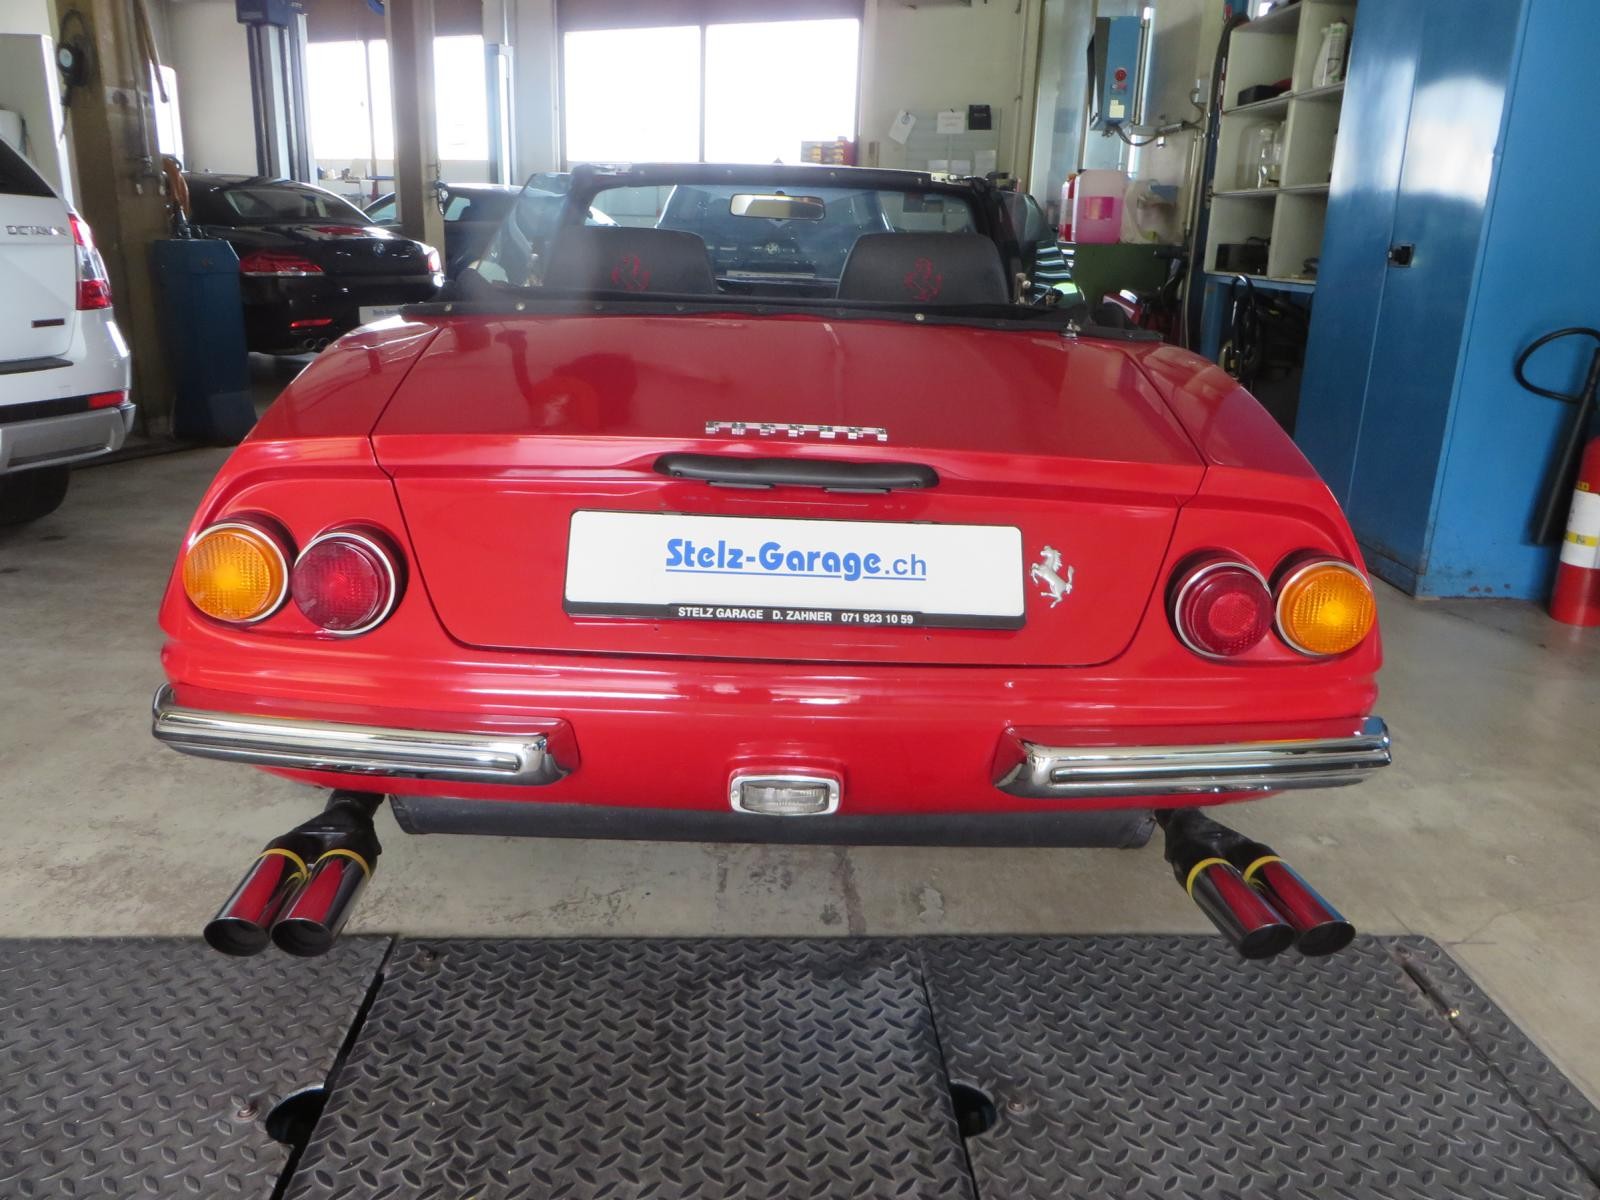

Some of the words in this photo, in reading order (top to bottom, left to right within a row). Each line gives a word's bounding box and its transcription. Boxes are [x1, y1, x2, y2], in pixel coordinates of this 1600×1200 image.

[665, 538, 927, 581] Stelz-Garage.ch
[678, 606, 714, 618] STELZ
[715, 608, 763, 619] GARAGE
[772, 610, 784, 620] D.
[786, 610, 833, 622] ZAHNER
[841, 612, 860, 622] 071
[862, 613, 882, 623] 923
[885, 614, 898, 624] 10
[900, 614, 914, 625] 59
